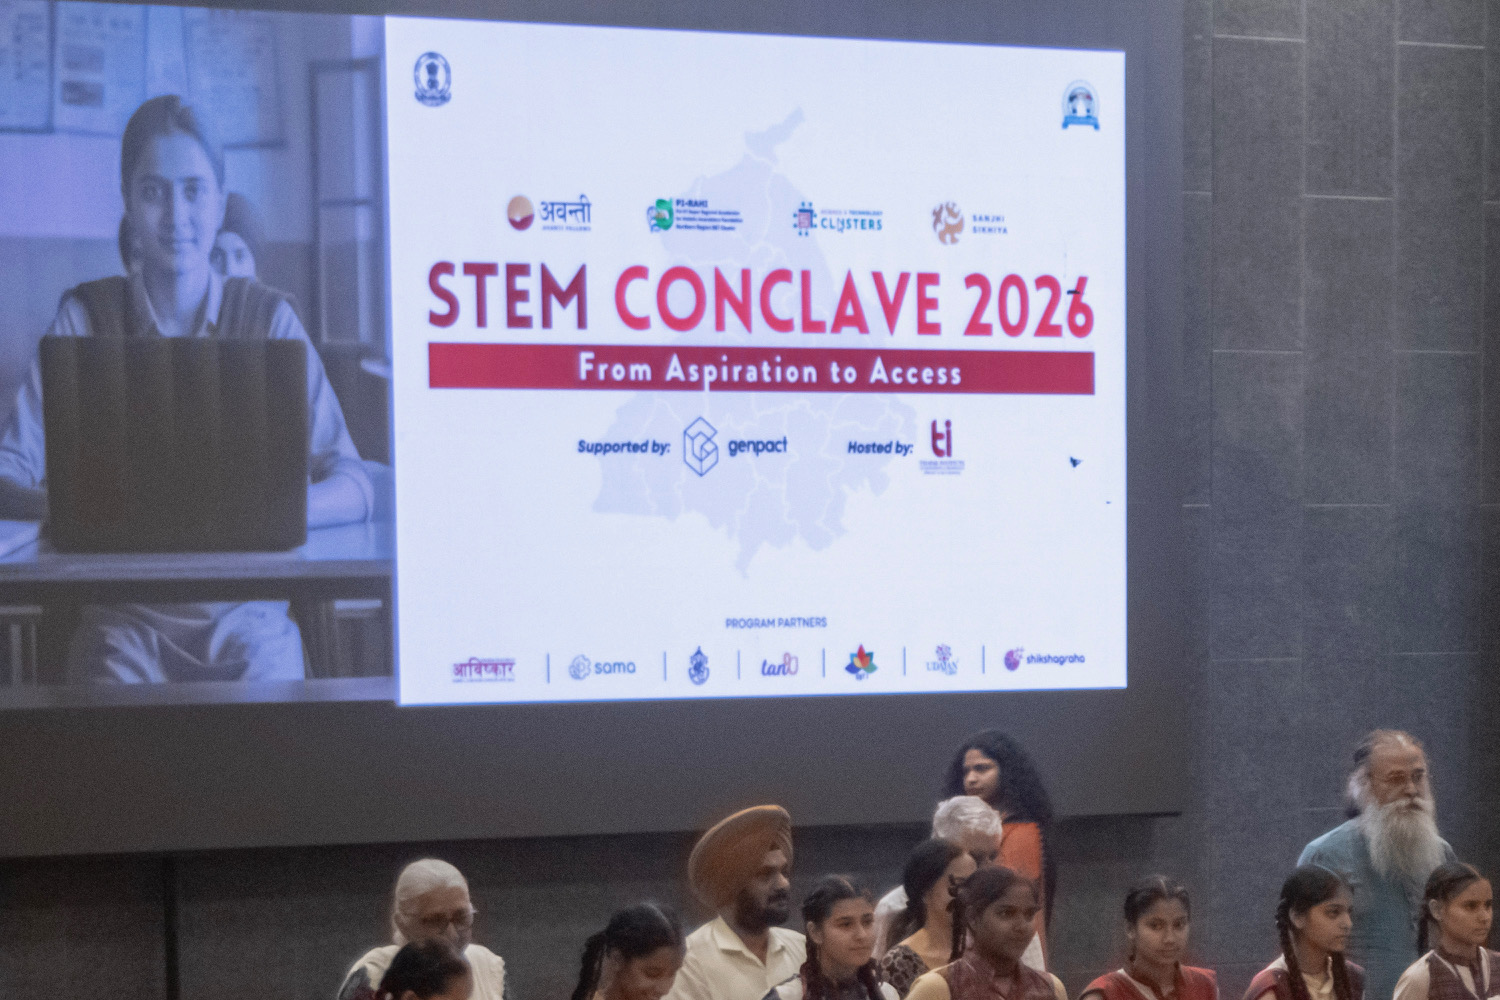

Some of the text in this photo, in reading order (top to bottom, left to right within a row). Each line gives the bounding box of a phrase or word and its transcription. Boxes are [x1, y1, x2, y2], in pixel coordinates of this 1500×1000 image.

[540, 193, 592, 223] अवन्ती
[820, 217, 883, 231] CLUSTERS
[971, 214, 1006, 223] SANJHI
[971, 225, 1009, 235] SIKHIYA
[427, 260, 1095, 339] STEM CONCLAVE 2026
[579, 352, 962, 392] From Aspiration to Access
[577, 439, 671, 456] Supported by:
[727, 436, 788, 457] genpact
[847, 440, 915, 457] Hosted by:
[725, 616, 828, 629] PROGRAM PARTNERS
[1026, 653, 1086, 666] shikshagraha
[594, 661, 636, 675] sama
